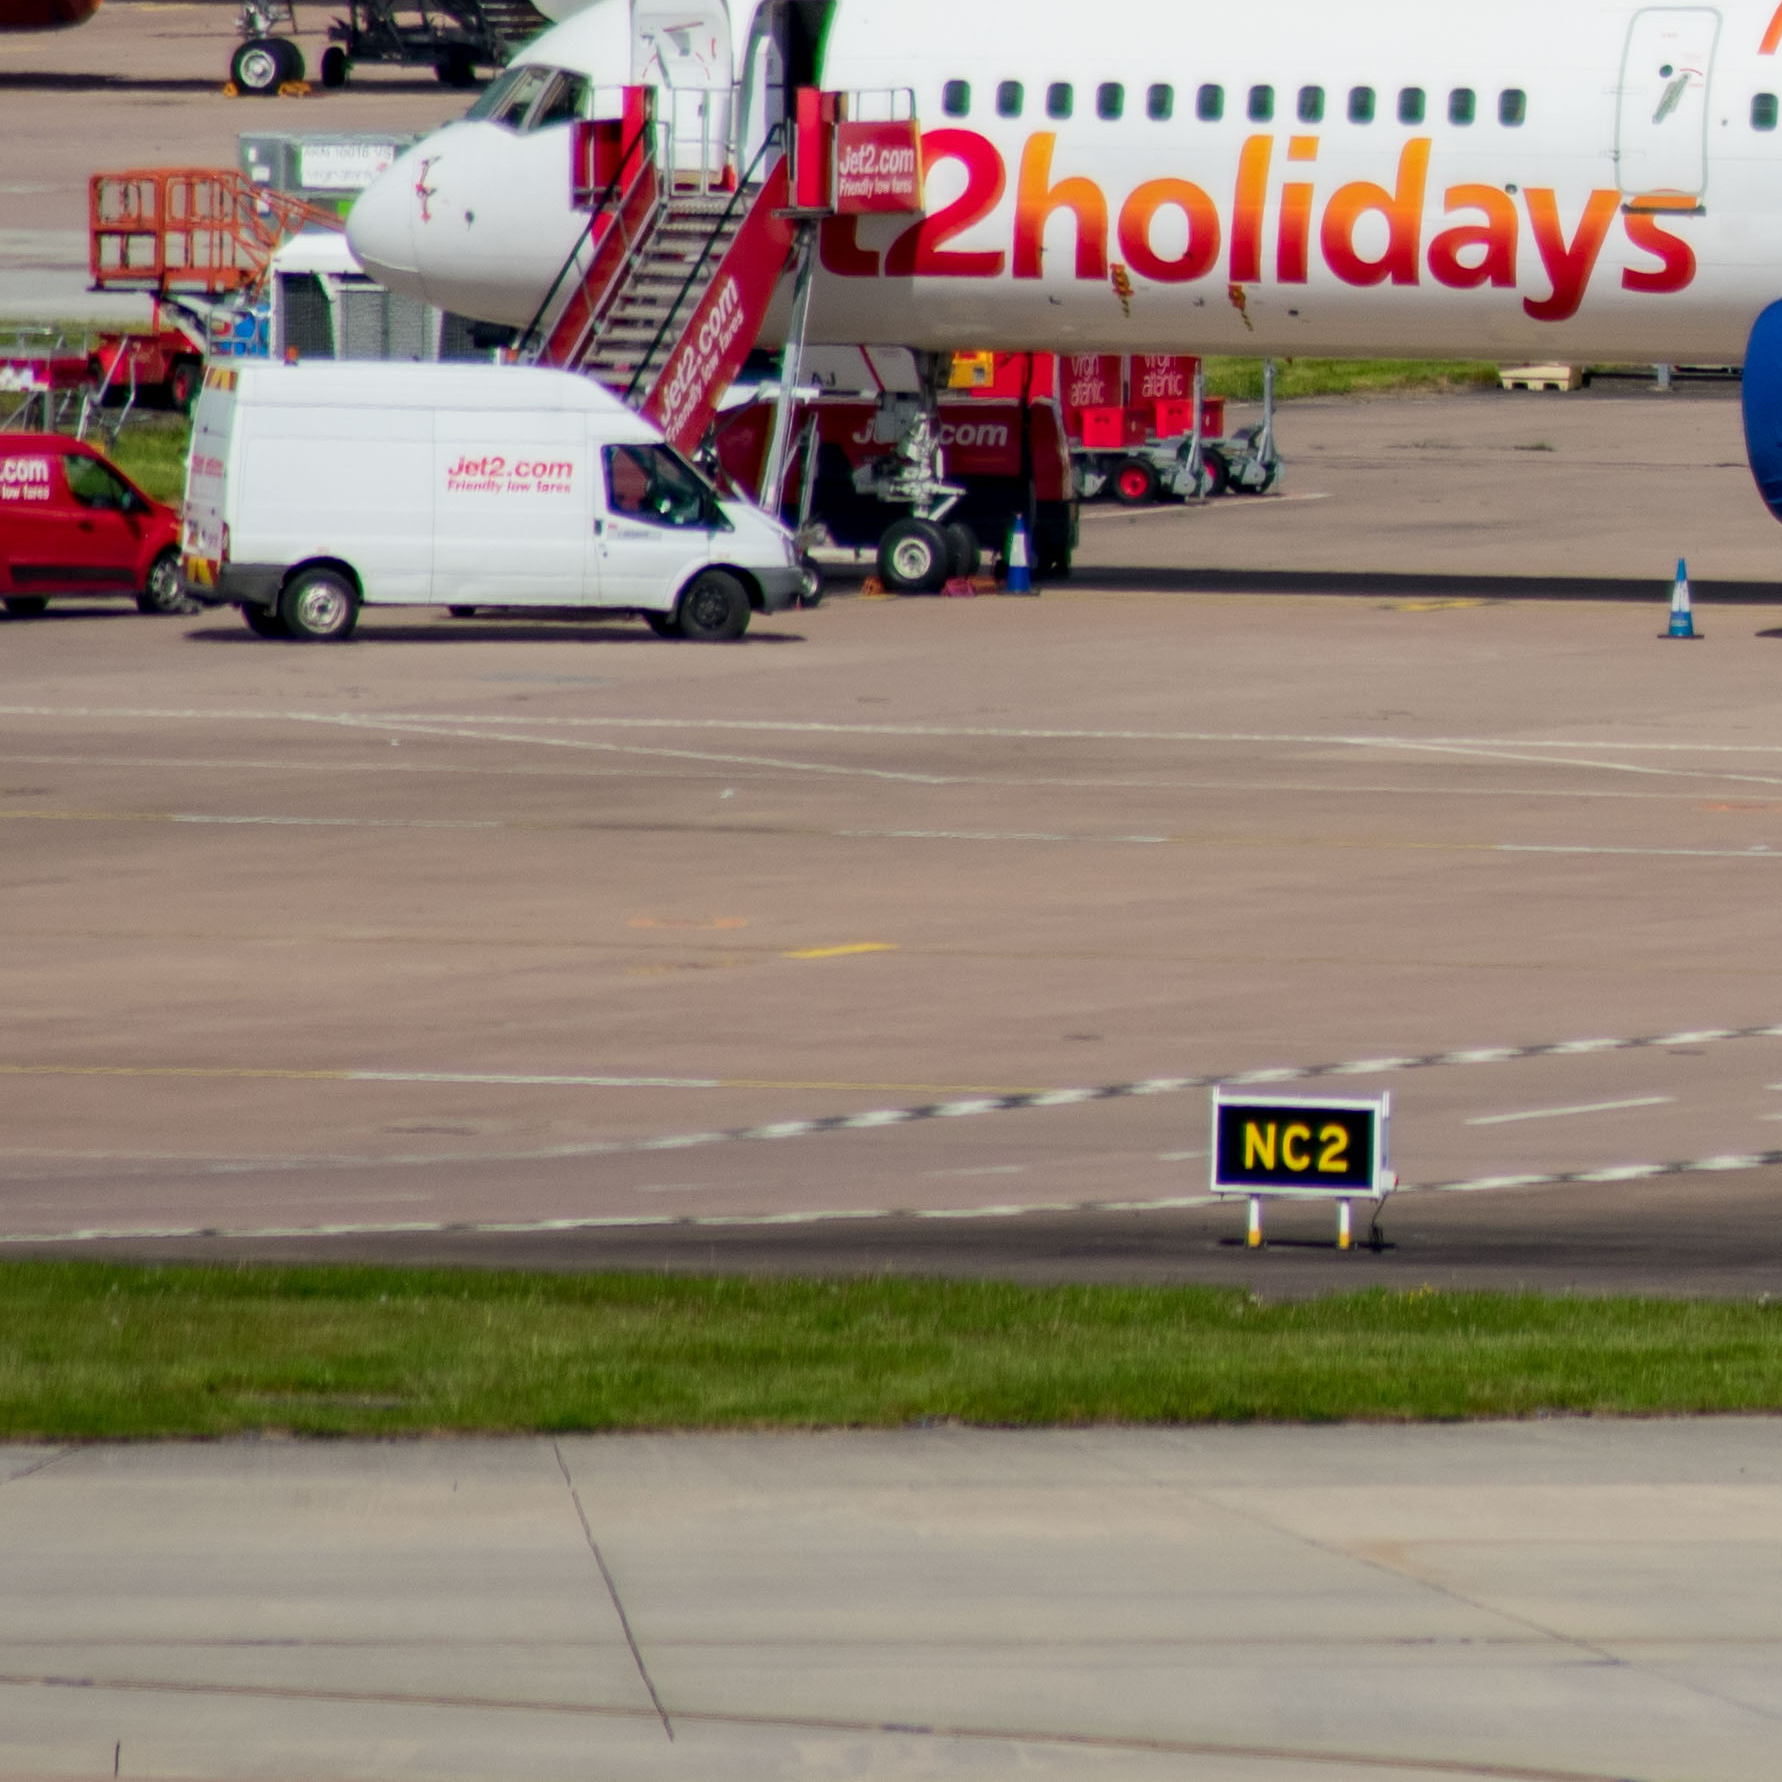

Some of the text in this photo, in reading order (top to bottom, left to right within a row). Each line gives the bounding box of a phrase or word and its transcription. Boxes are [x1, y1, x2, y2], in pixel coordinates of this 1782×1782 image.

[839, 144, 914, 176] Jet2.com
[660, 275, 739, 429] Jet2.com
[447, 454, 574, 479] Jet2.com
[447, 479, 571, 495] Friendly low fares
[1243, 1121, 1349, 1174] NC2
